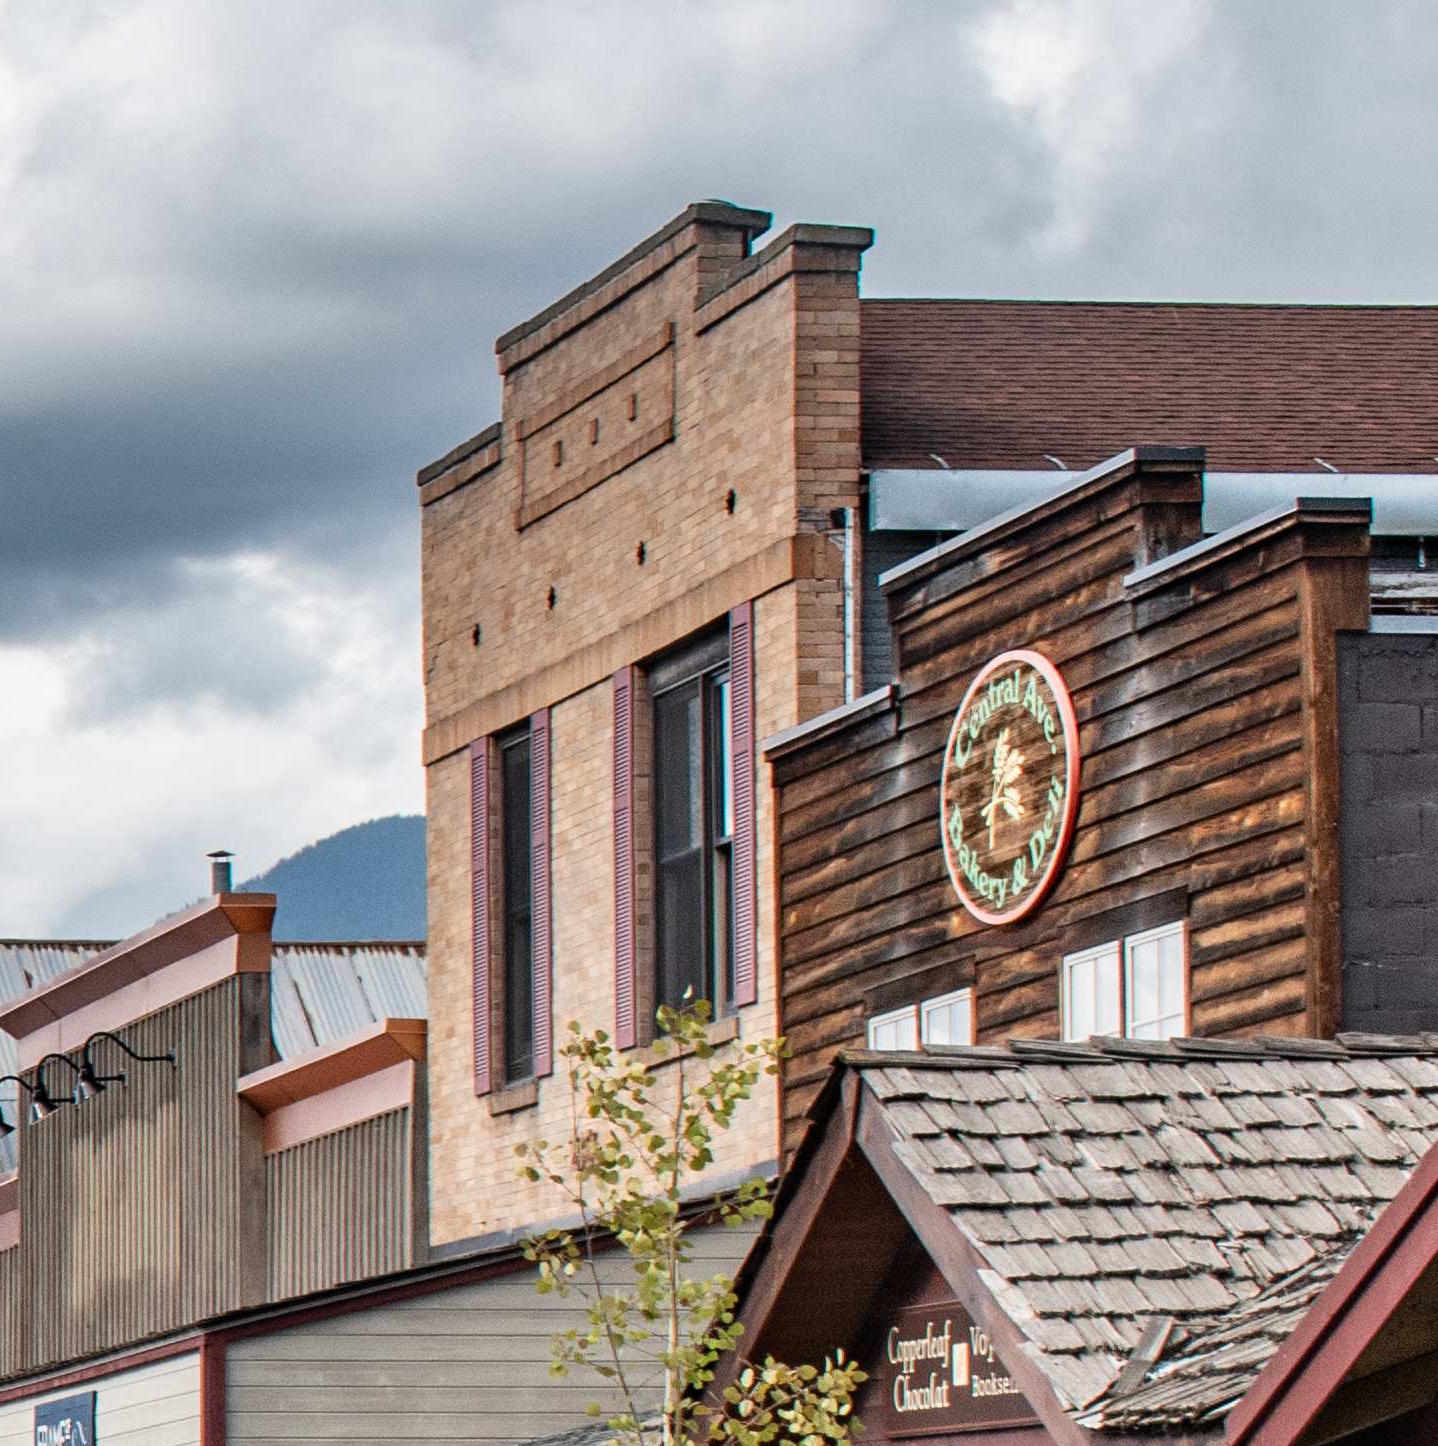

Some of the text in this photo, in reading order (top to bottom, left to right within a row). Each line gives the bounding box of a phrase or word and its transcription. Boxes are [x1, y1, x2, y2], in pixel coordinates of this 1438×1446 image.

[955, 669, 1058, 769] Central Ave.
[948, 775, 1063, 909] Bakery & Deli
[887, 1319, 951, 1373] Copperleaf
[893, 1371, 950, 1412] Chocolat
